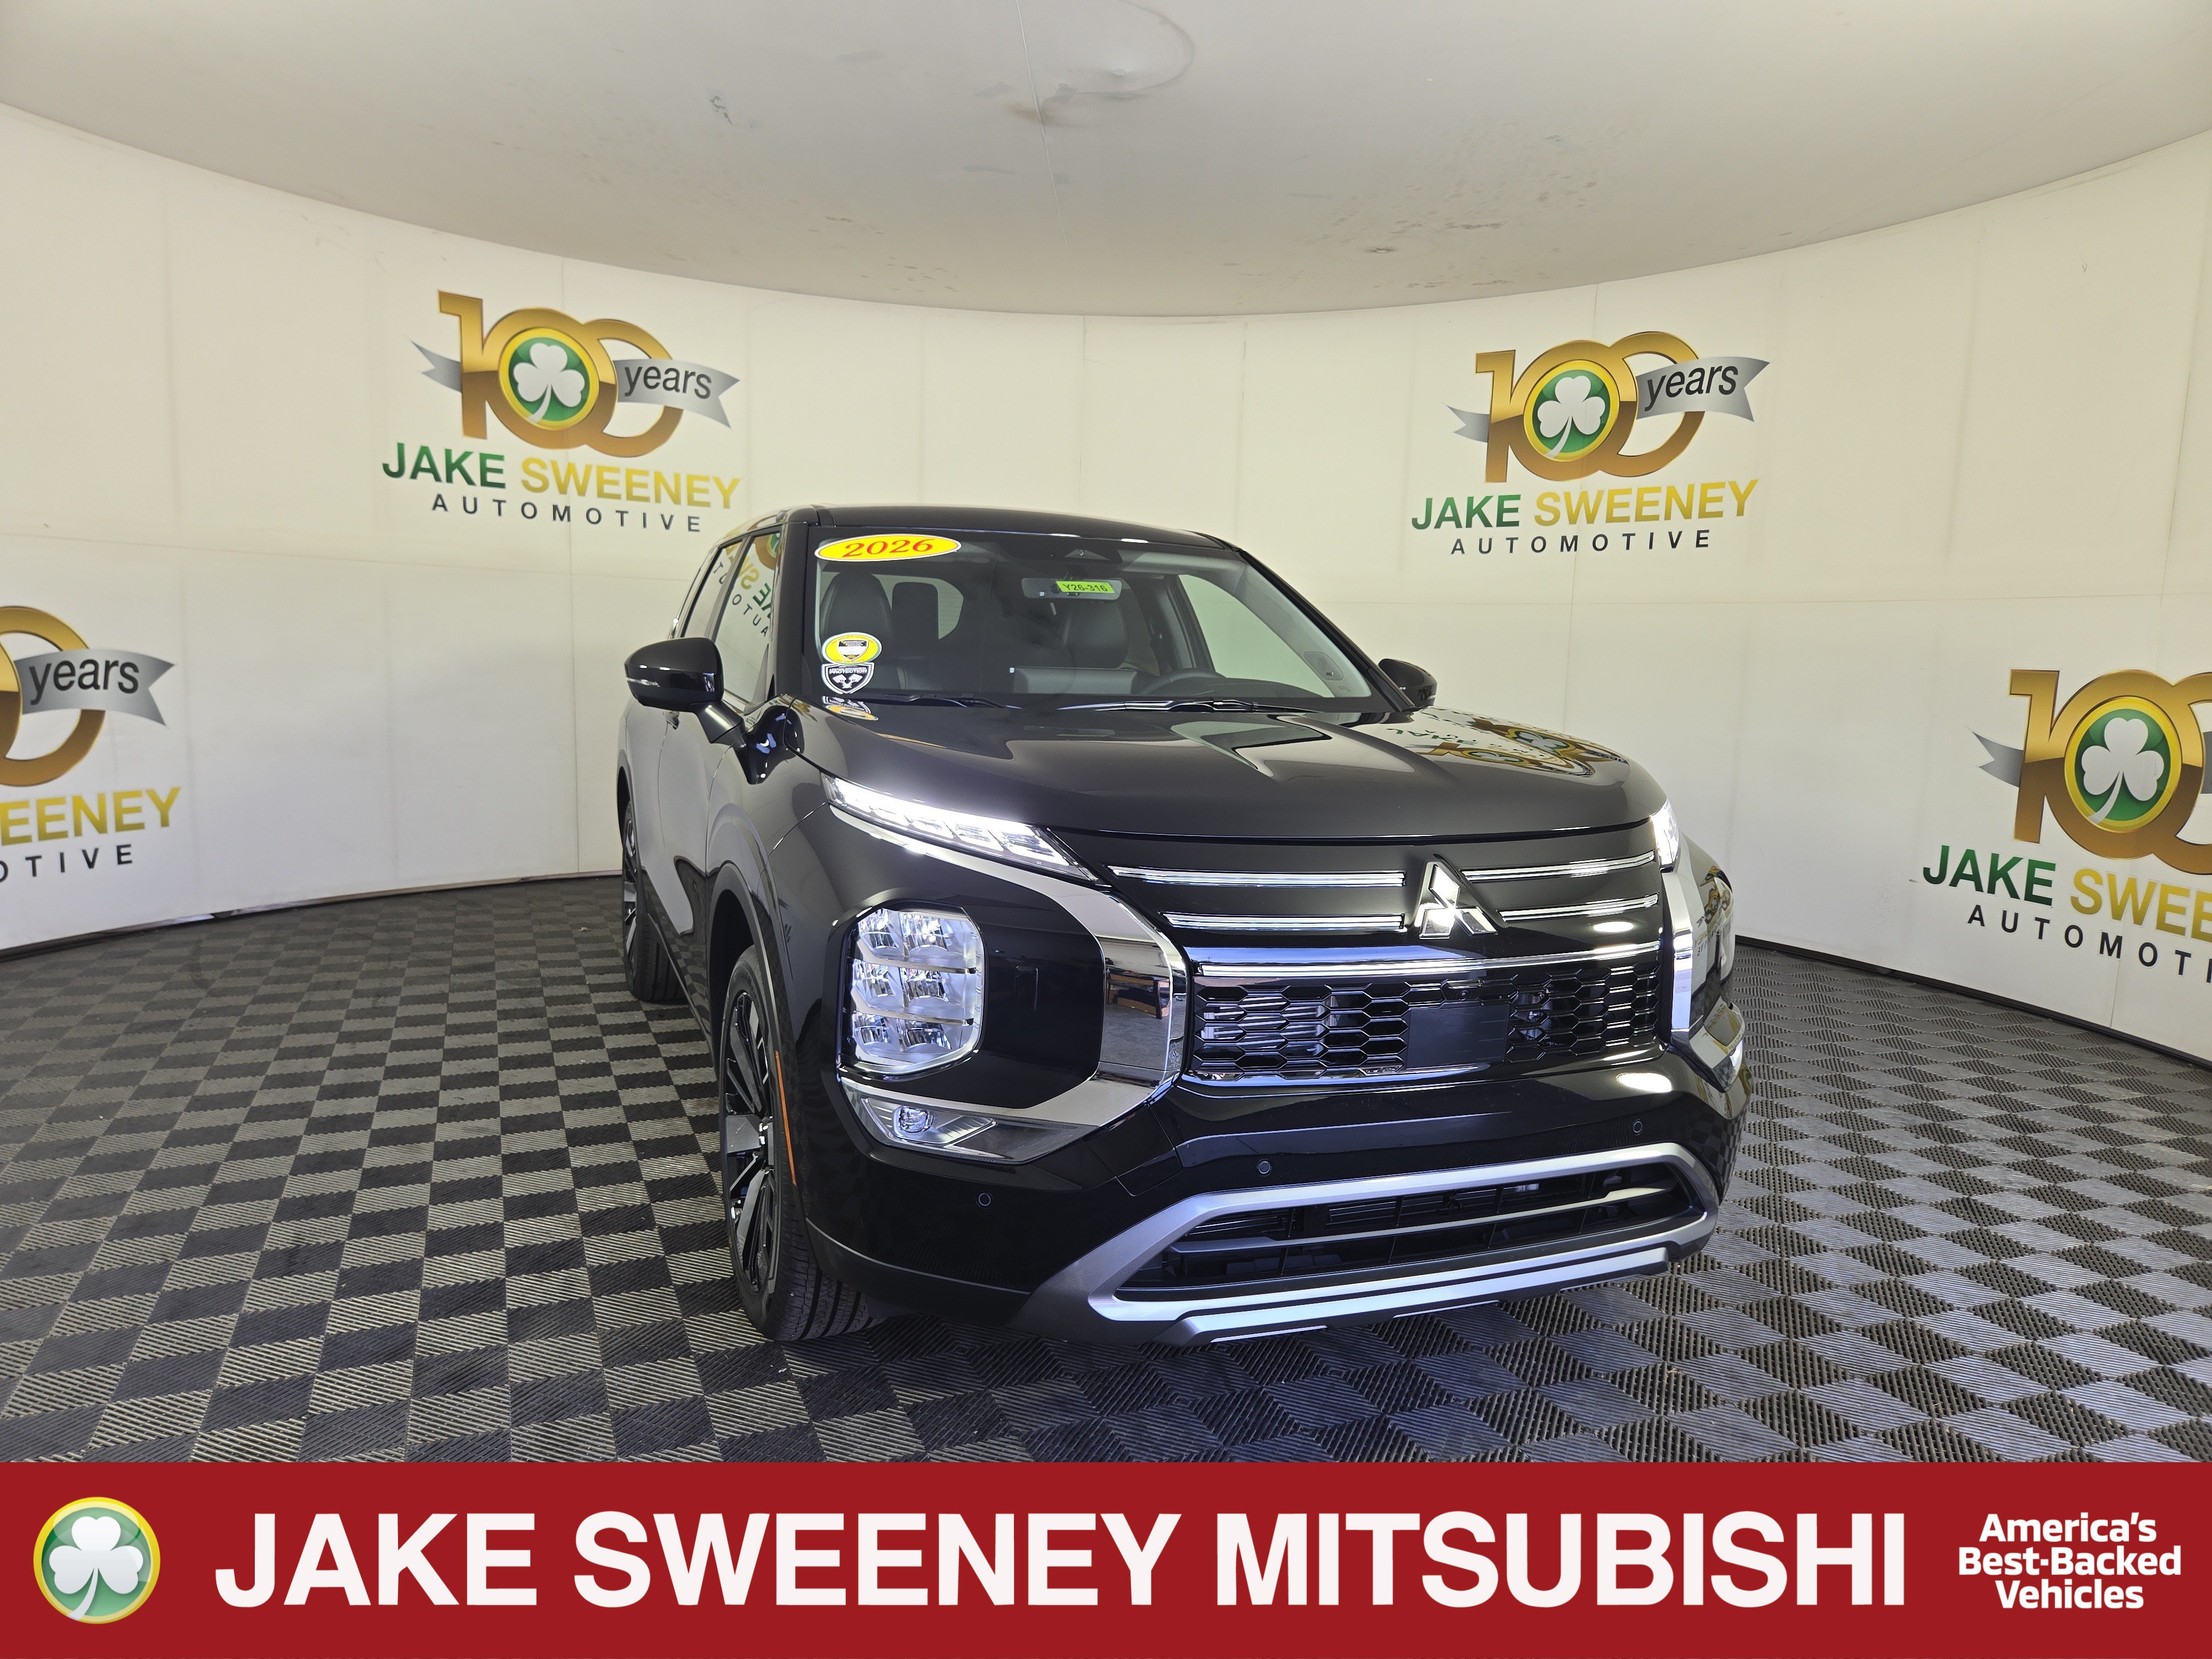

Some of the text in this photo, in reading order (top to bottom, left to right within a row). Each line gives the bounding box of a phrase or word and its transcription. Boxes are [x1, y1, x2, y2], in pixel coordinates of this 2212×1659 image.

[623, 365, 712, 399] years
[1644, 365, 1738, 411] years
[382, 442, 741, 509] JAKE SWEENEY
[432, 493, 701, 532] AUTOMOTIVE
[1412, 479, 1759, 530] JAKE SWEENEY
[842, 539, 934, 558] 2026
[1451, 529, 1710, 555] AUTOMOTIVE
[1063, 583, 1108, 591] Y26-316
[28, 659, 139, 705] years
[1923, 845, 2056, 906] JAKE
